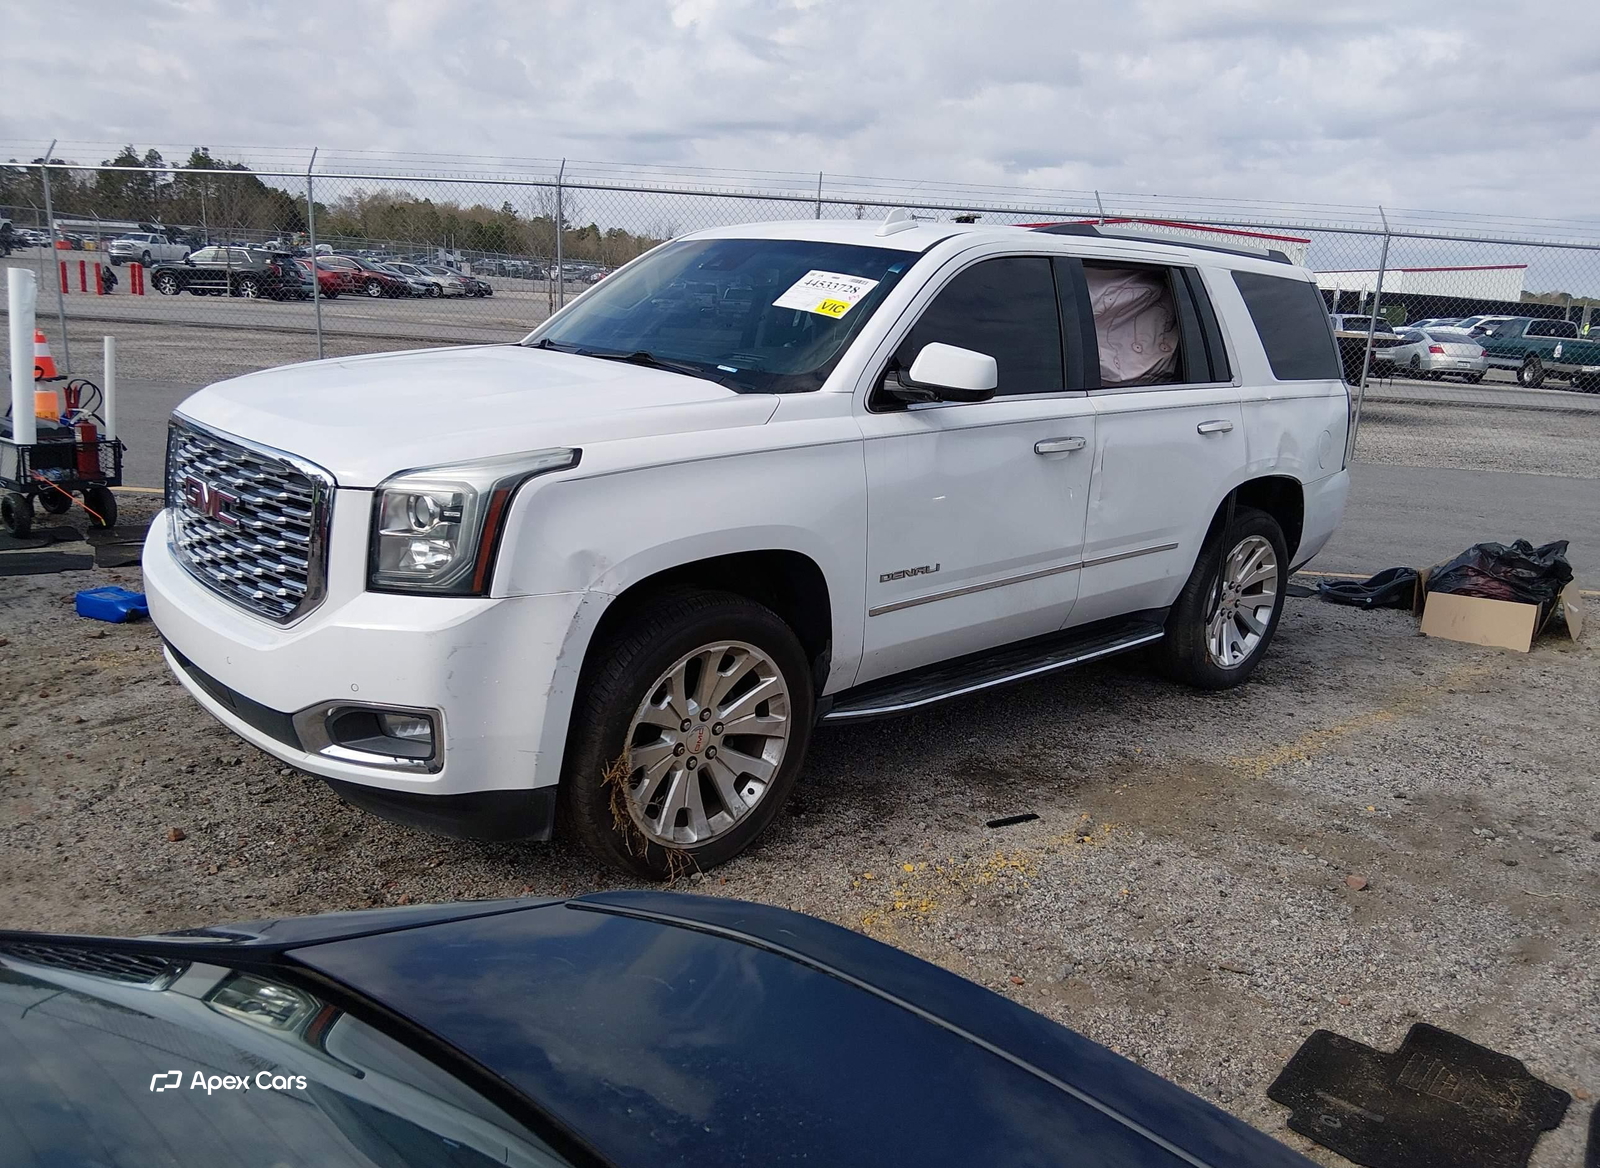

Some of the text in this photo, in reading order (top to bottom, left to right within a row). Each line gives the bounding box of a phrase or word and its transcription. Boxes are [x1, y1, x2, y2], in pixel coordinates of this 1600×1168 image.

[804, 278, 861, 295] 44533728
[821, 301, 846, 314] VIC
[185, 474, 240, 527] GMC
[879, 563, 941, 583] DENALI
[694, 727, 705, 752] GMC
